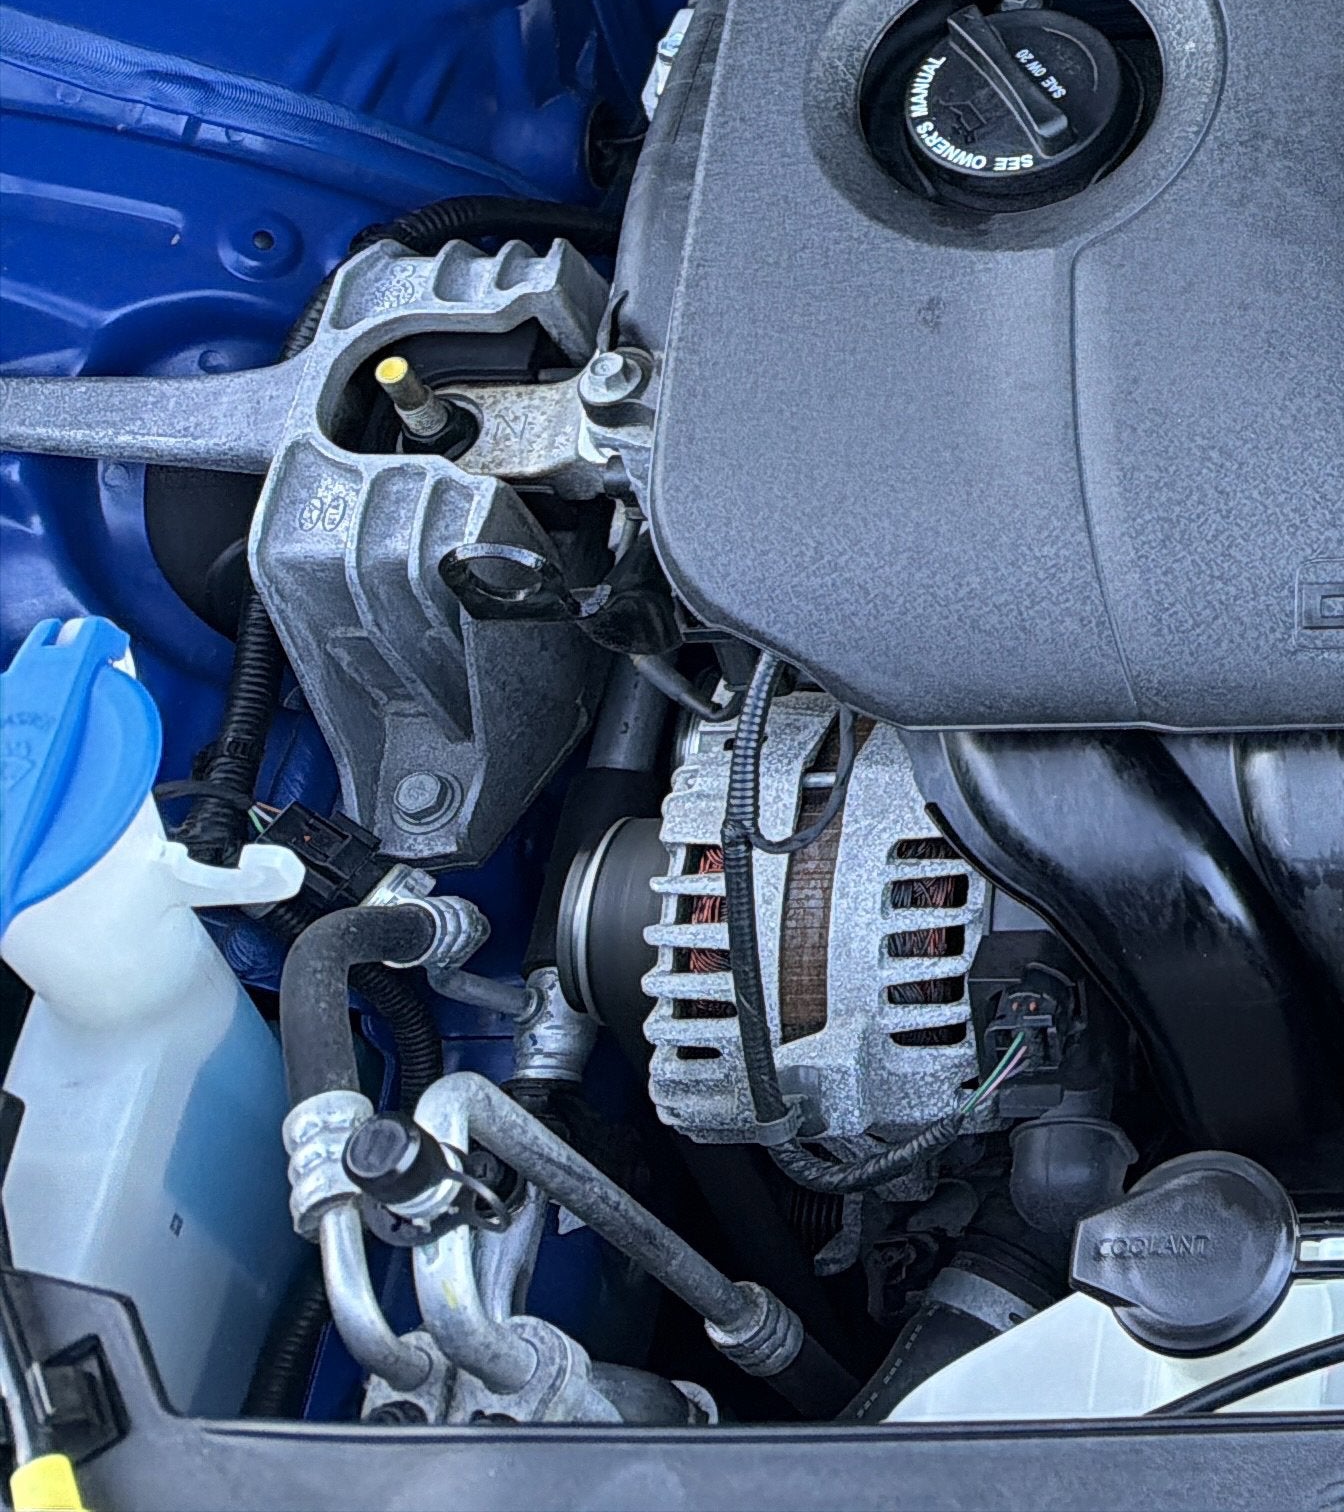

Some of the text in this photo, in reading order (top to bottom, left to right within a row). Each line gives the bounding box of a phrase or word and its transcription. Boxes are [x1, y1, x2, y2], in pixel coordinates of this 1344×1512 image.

[1040, 75, 1067, 99] SAE
[909, 54, 1035, 172] SEE OWNER'S MANUAL
[1098, 1234, 1210, 1258] COOLANT
